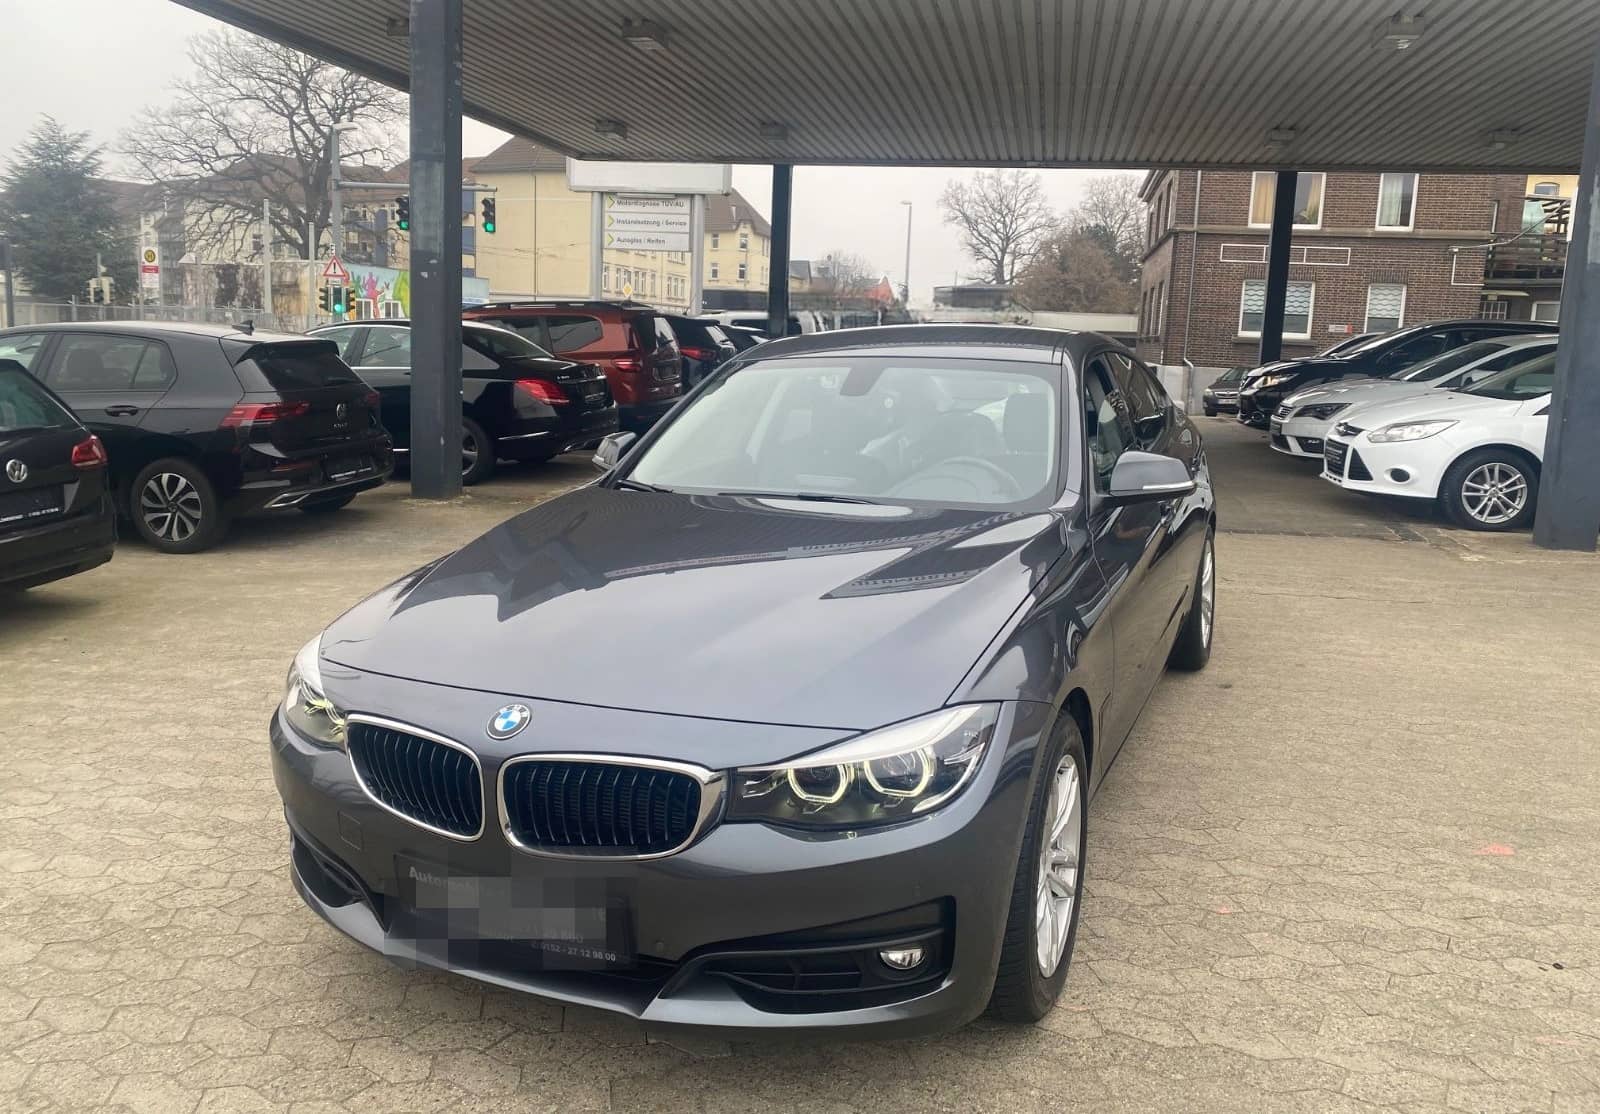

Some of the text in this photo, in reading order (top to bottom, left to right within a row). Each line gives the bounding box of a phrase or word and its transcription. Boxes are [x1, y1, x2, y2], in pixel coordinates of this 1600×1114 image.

[616, 218, 660, 227] Instandsetzung
[665, 218, 687, 226] Service
[616, 237, 642, 245] Autoglas
